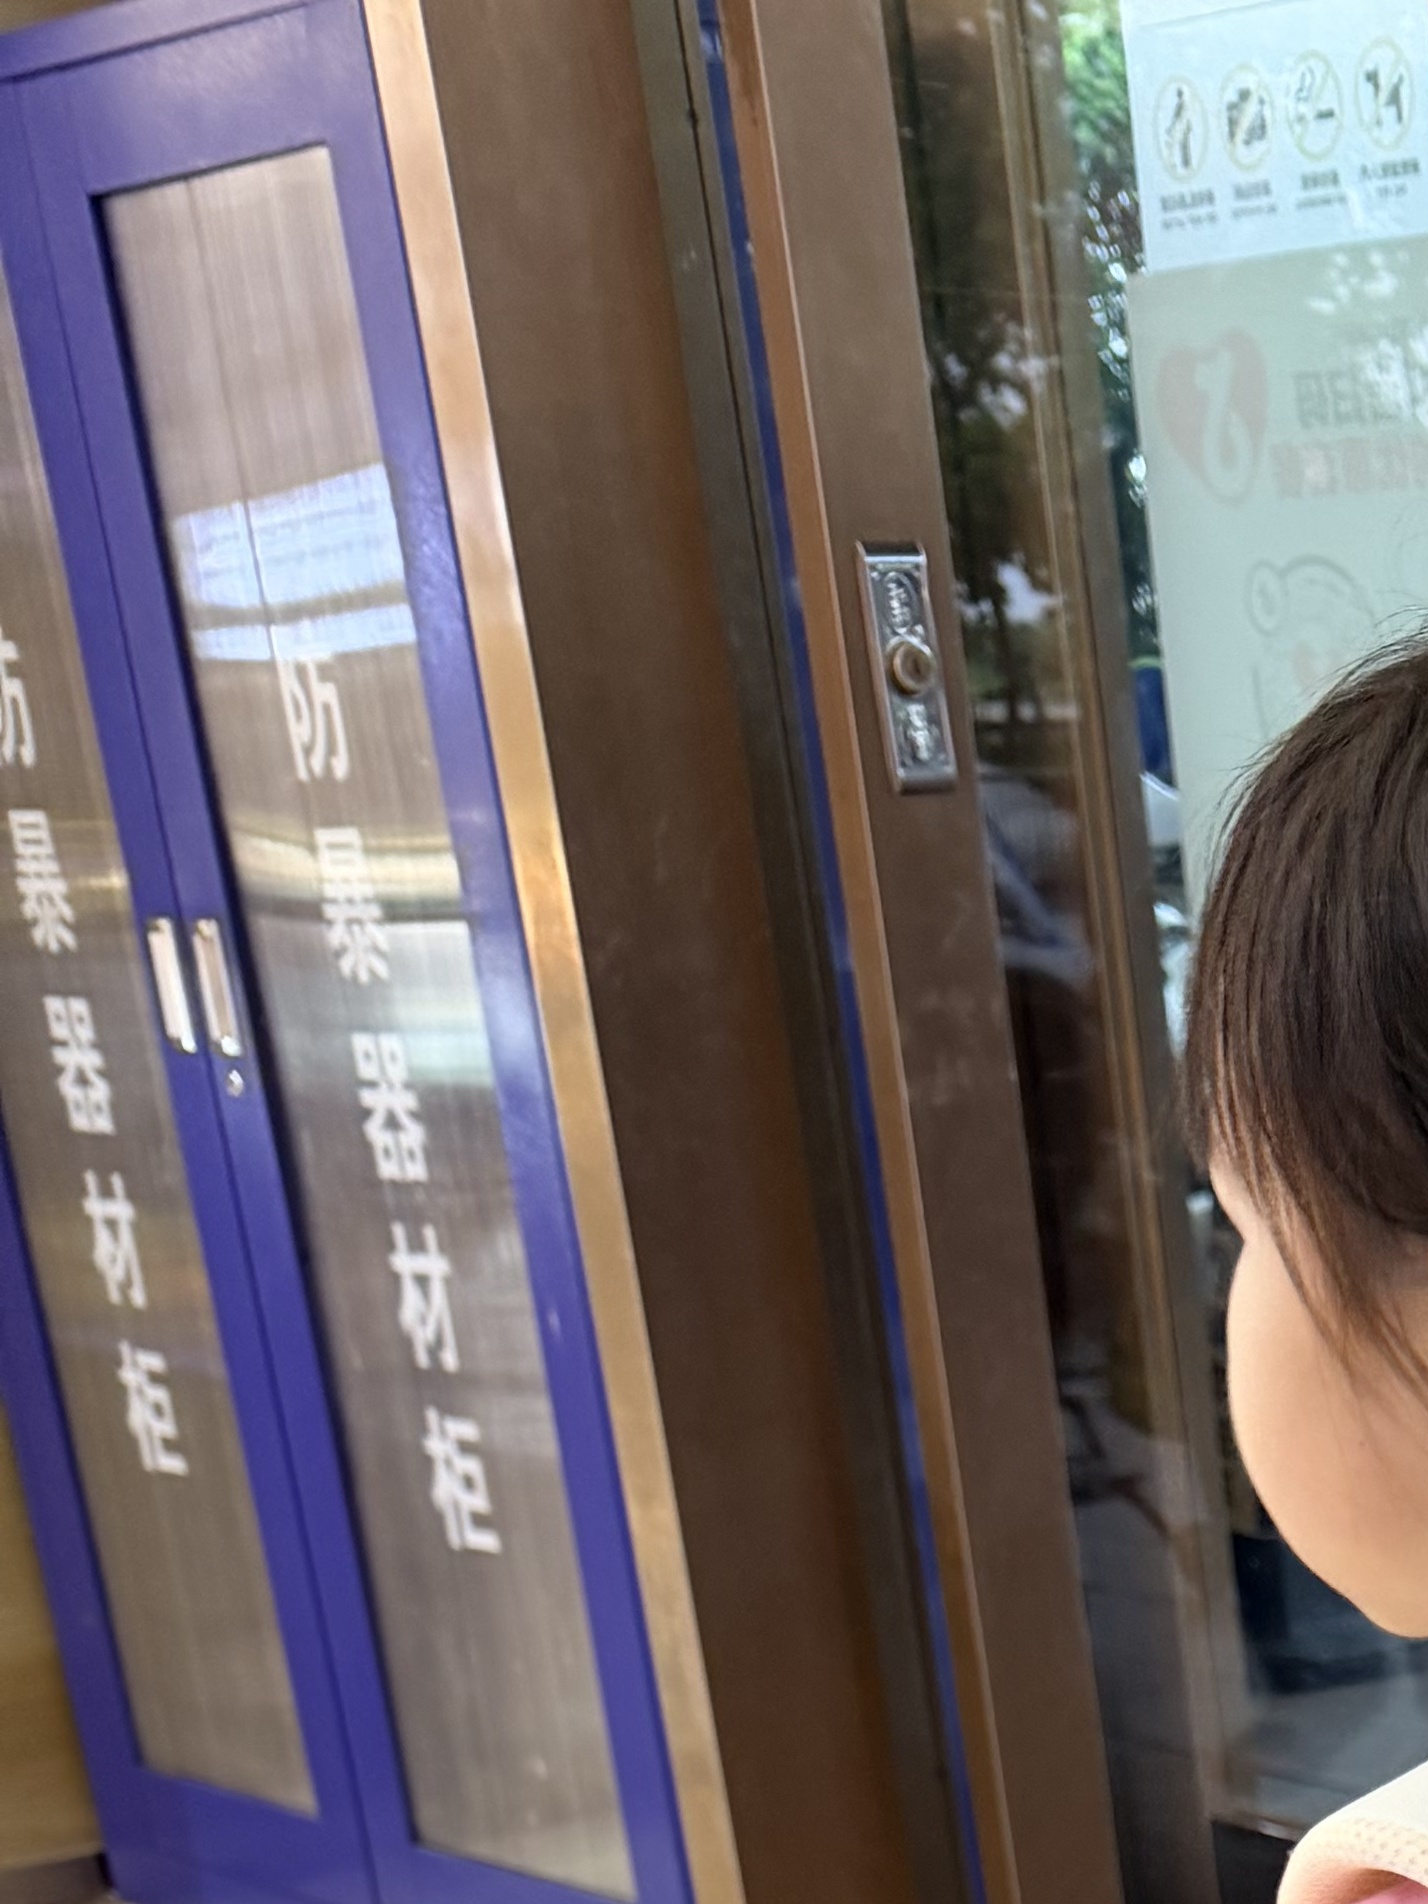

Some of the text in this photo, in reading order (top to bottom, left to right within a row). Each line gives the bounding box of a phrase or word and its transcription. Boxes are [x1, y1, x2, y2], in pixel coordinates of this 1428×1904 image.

[280, 650, 502, 1554] 防暴器材柜
